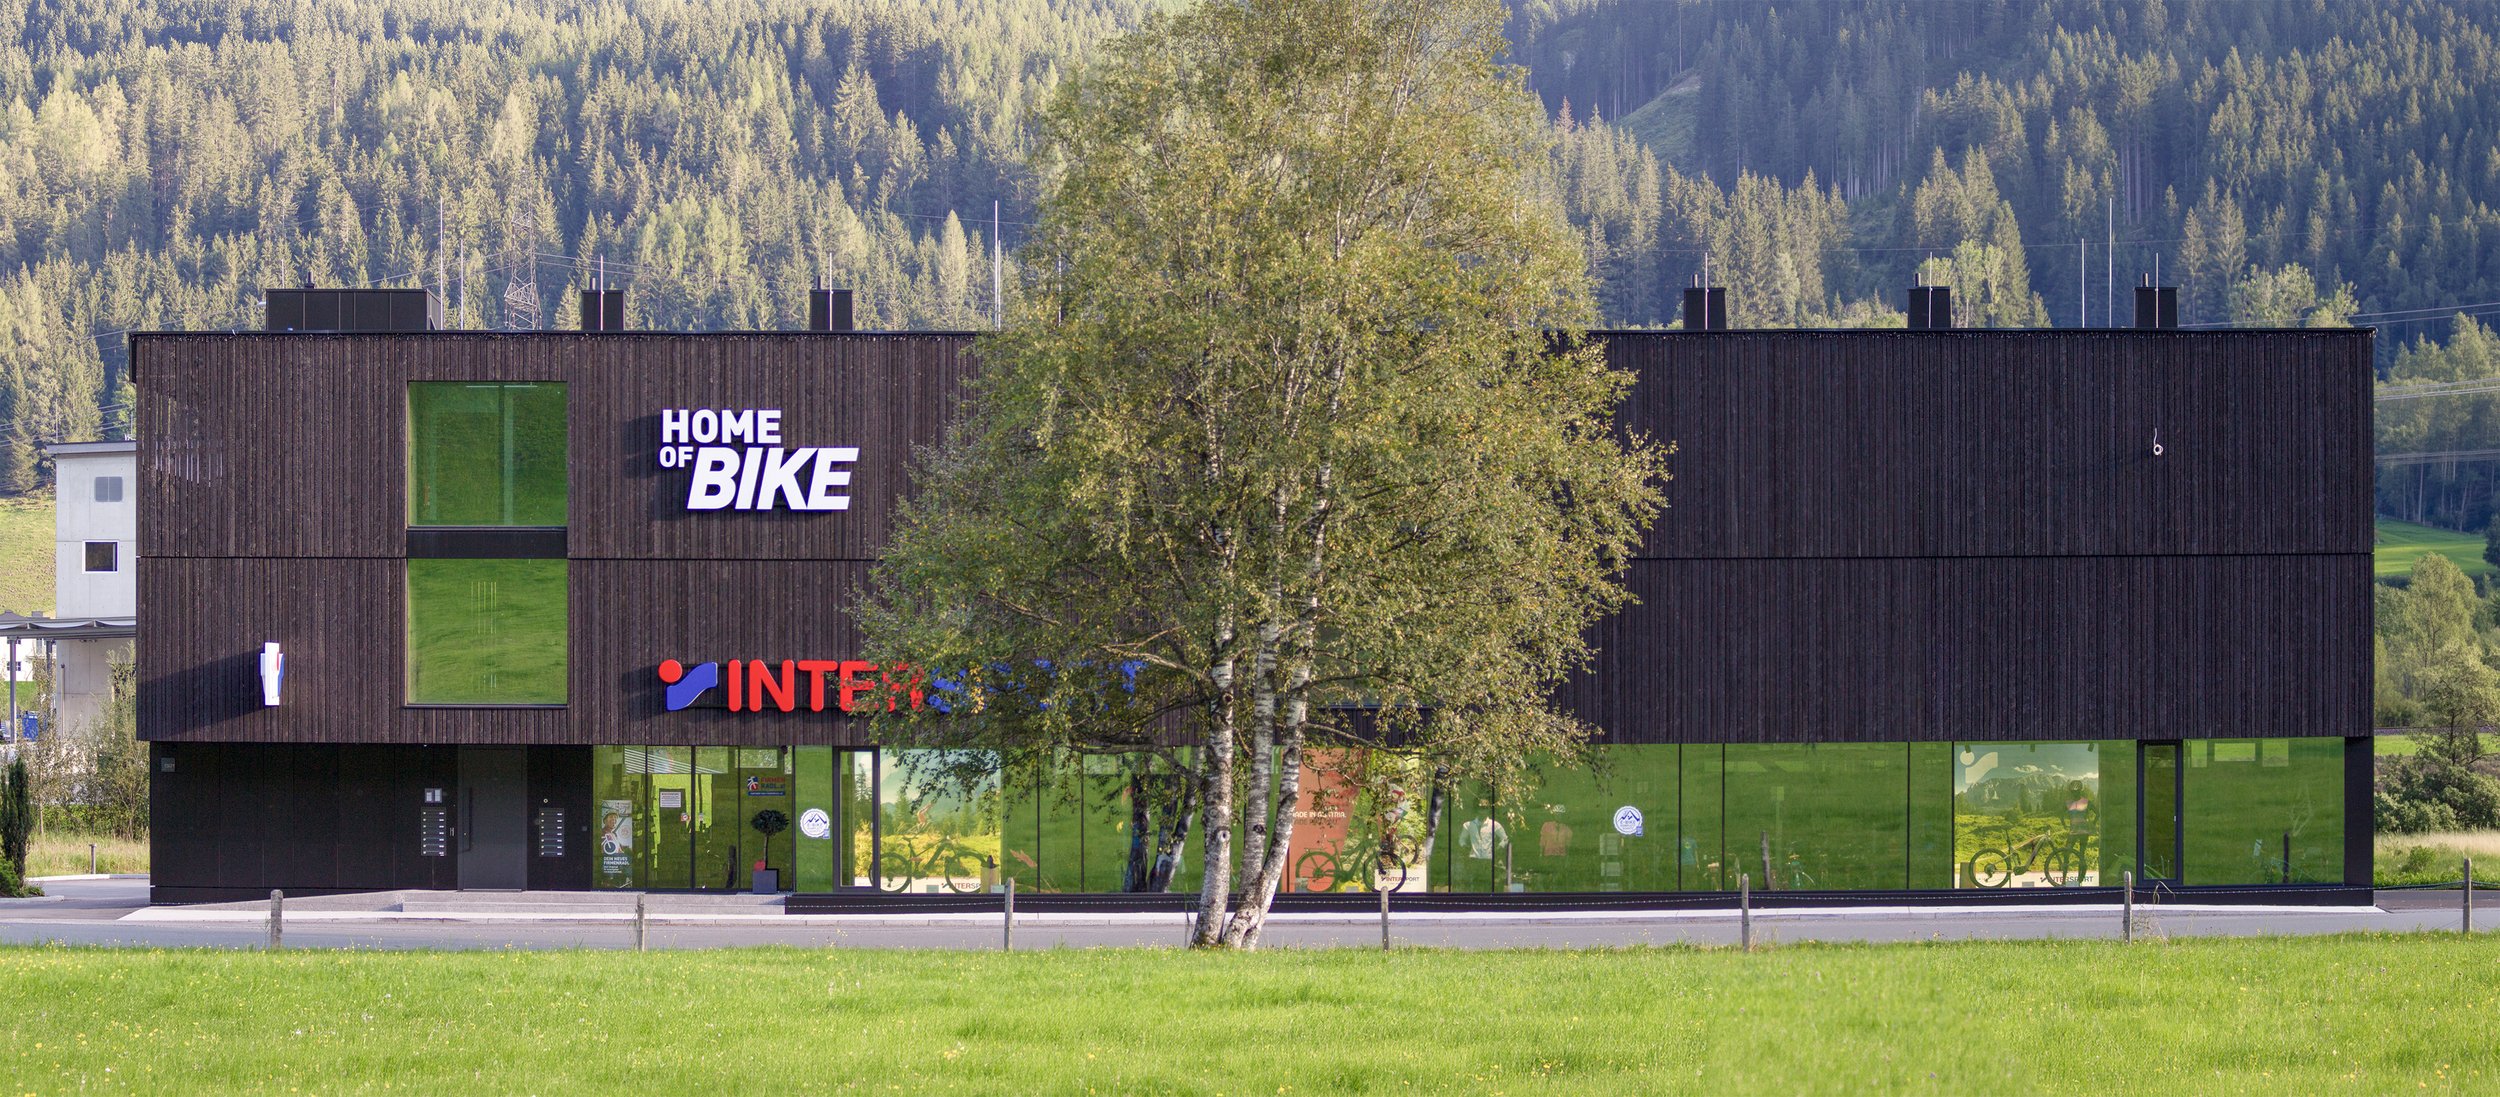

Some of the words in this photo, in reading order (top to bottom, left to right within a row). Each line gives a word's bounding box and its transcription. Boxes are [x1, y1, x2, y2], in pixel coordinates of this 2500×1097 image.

[662, 409, 782, 444] HOME
[659, 446, 694, 468] OF
[686, 447, 859, 511] BIKE
[728, 659, 1148, 713] INTERST
